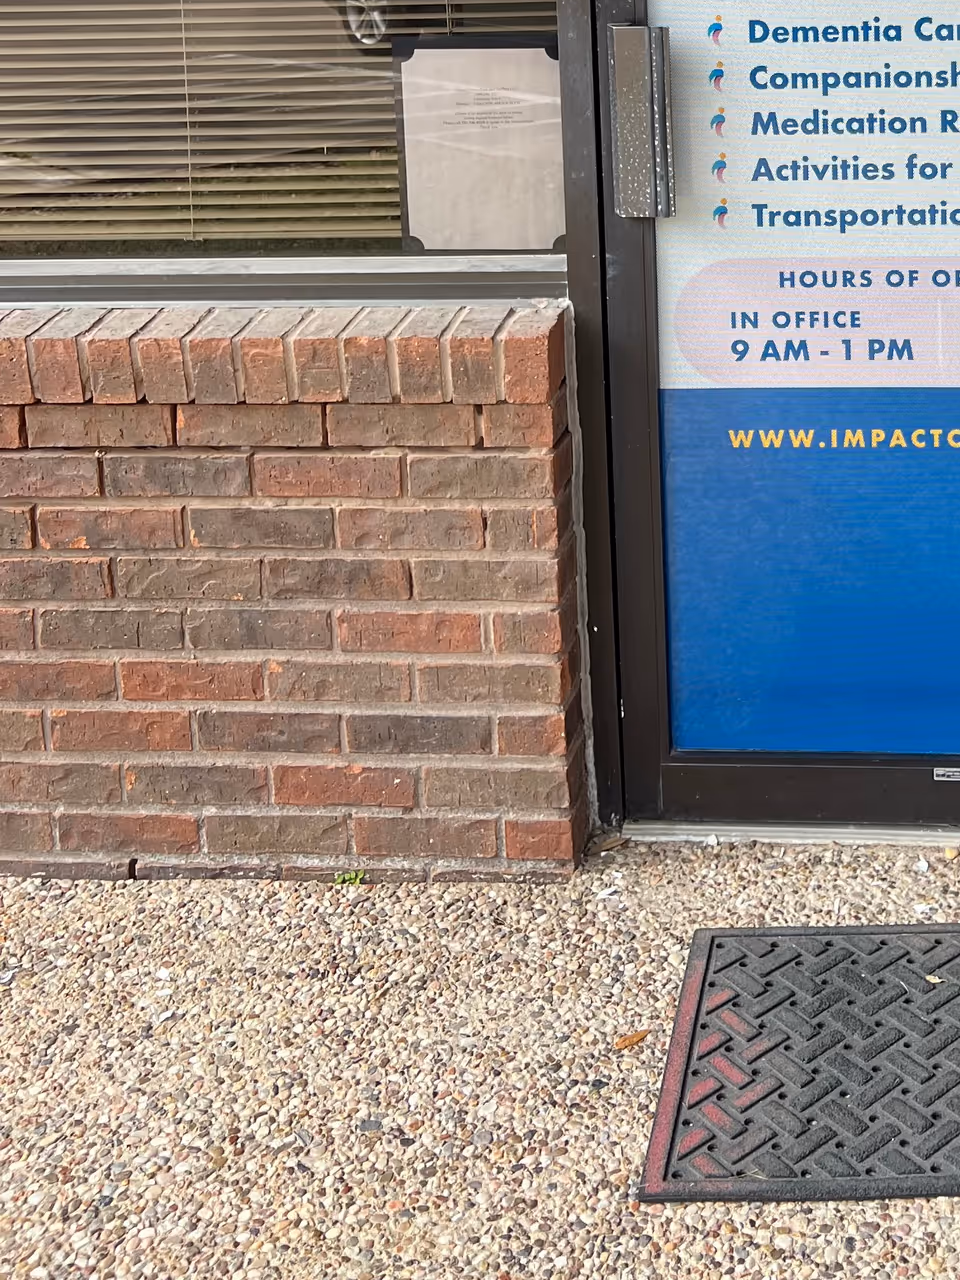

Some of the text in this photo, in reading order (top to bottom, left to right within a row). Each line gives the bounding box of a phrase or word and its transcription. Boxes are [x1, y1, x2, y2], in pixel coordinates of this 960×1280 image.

[748, 16, 902, 44] Dementia
[750, 108, 928, 136] Medication
[751, 155, 895, 182] Activities
[905, 153, 954, 180] for
[779, 269, 873, 289] HOURS
[885, 269, 919, 288] OF
[730, 310, 861, 329] IN OFFICE
[730, 339, 750, 362] 9
[759, 339, 810, 362] AM
[841, 339, 852, 361] 1
[868, 338, 914, 361] PM
